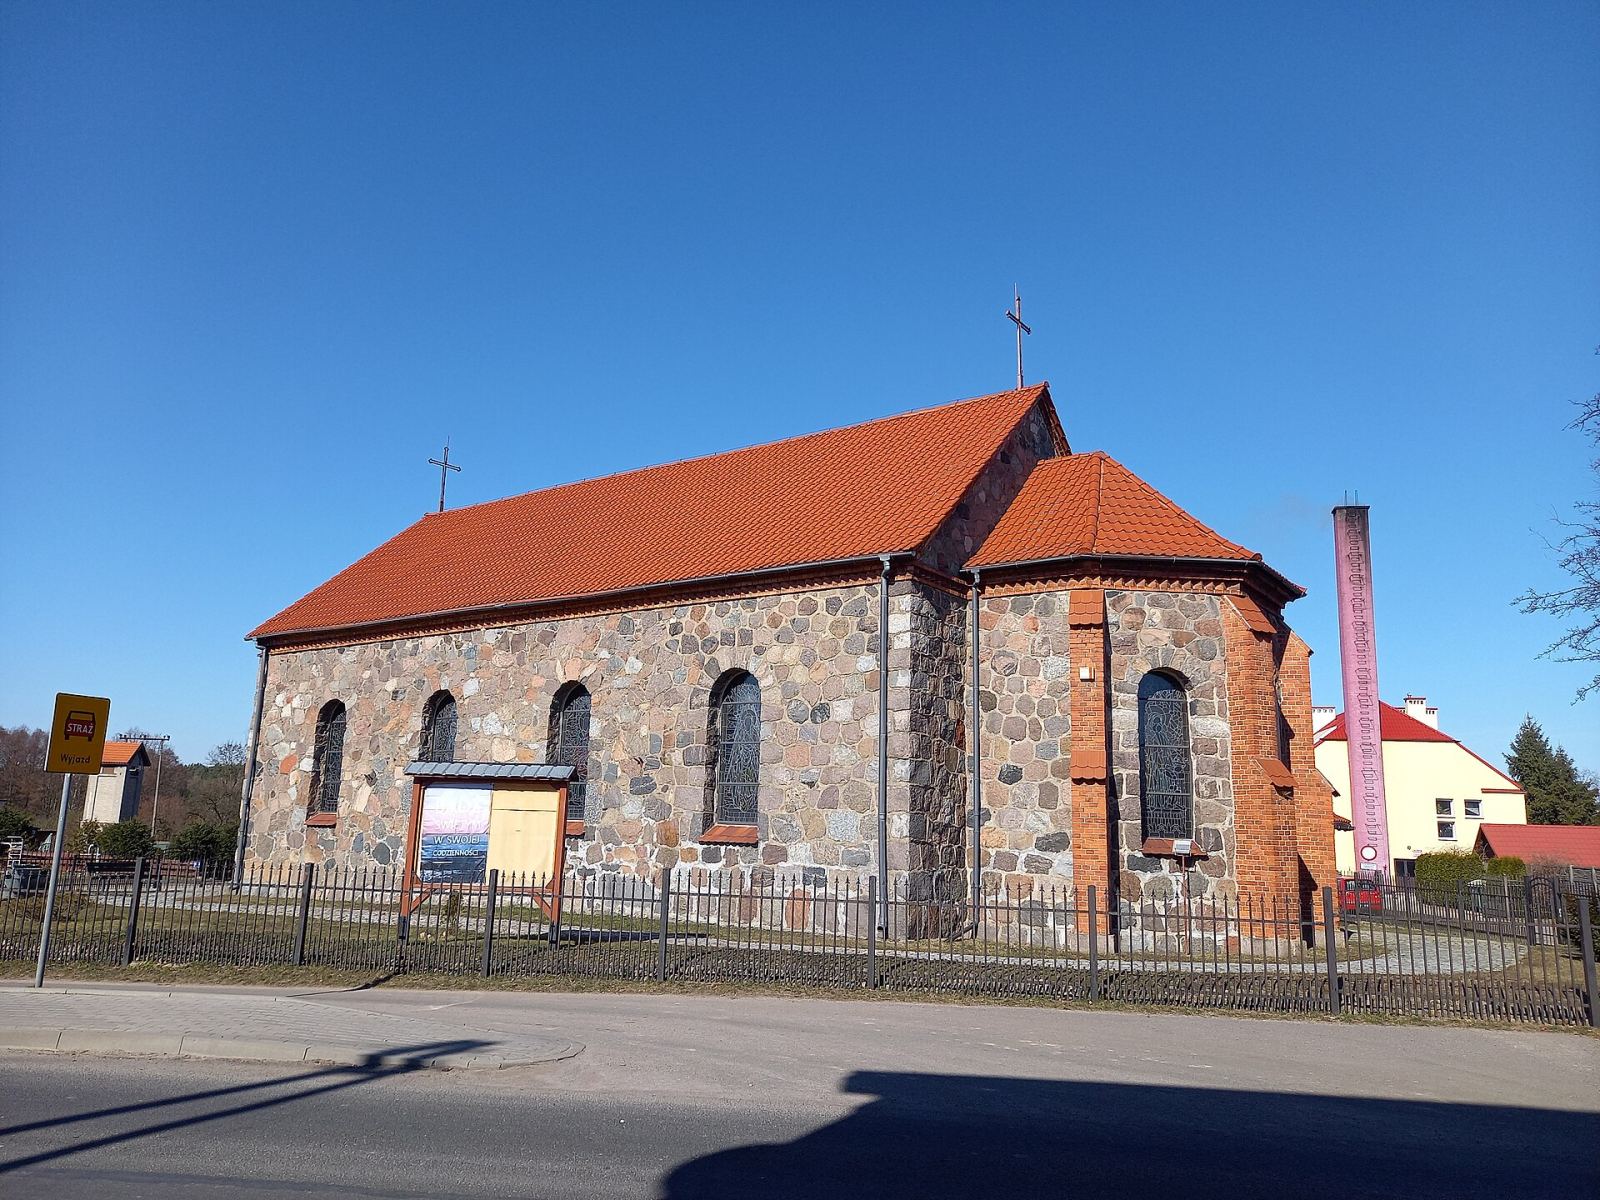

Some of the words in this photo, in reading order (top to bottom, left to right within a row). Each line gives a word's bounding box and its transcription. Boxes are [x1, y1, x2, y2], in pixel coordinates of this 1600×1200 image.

[67, 723, 93, 733] STRAŻ
[61, 754, 90, 765] Wyjazd
[434, 836, 443, 844] W
[447, 835, 480, 844] SWOJEJ
